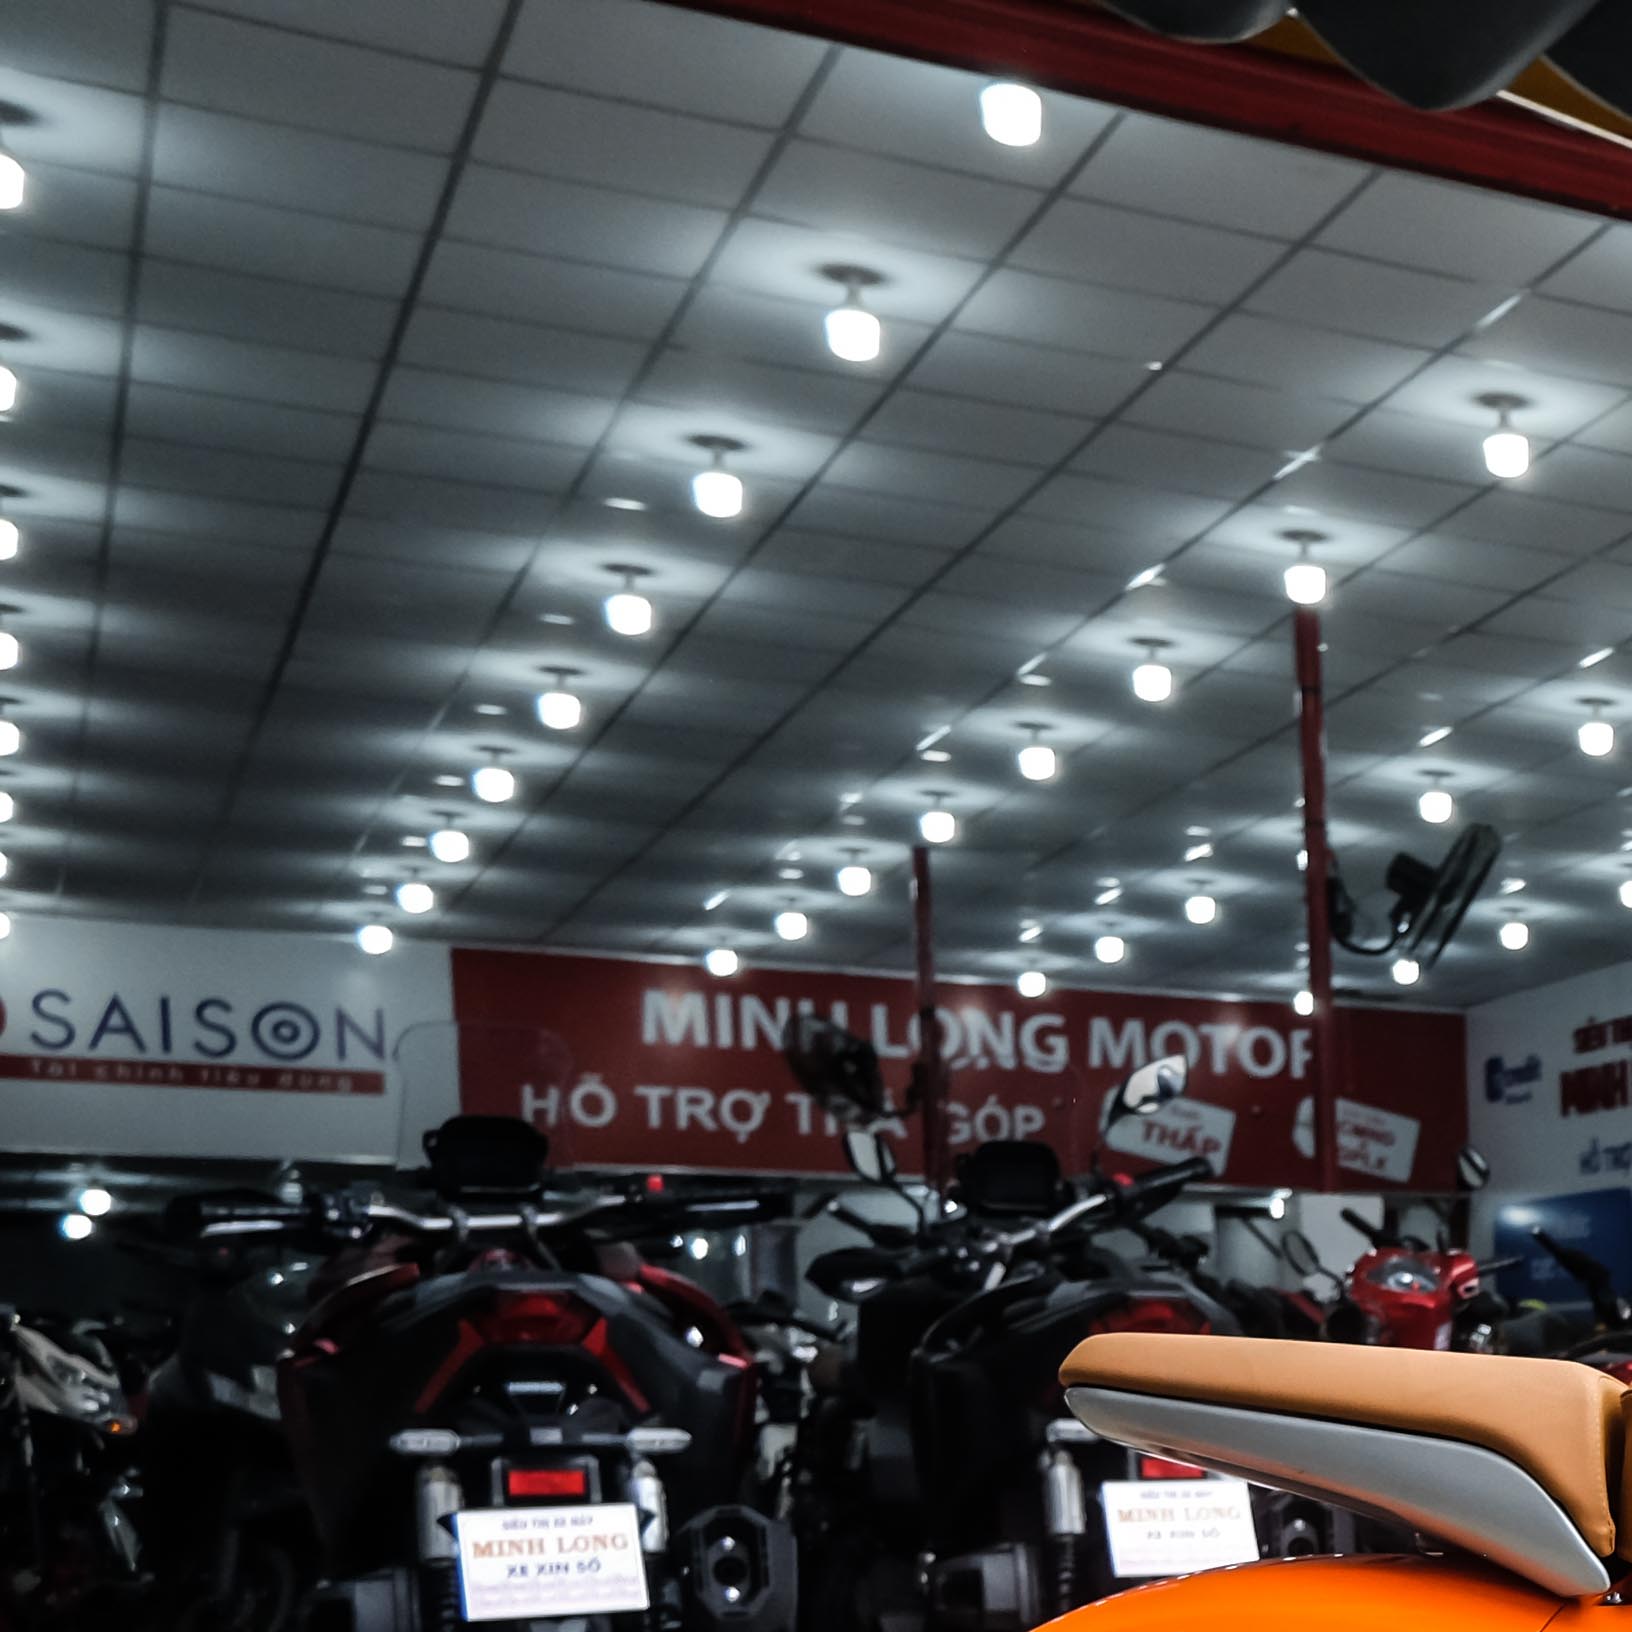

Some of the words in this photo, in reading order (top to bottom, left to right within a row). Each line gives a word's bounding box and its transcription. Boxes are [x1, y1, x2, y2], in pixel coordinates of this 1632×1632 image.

[30, 989, 386, 1062] SAISON
[870, 1003, 1069, 1072] LONG
[634, 1084, 772, 1144] TRỢ
[472, 1537, 545, 1559] MINH
[557, 1533, 629, 1555] LONG
